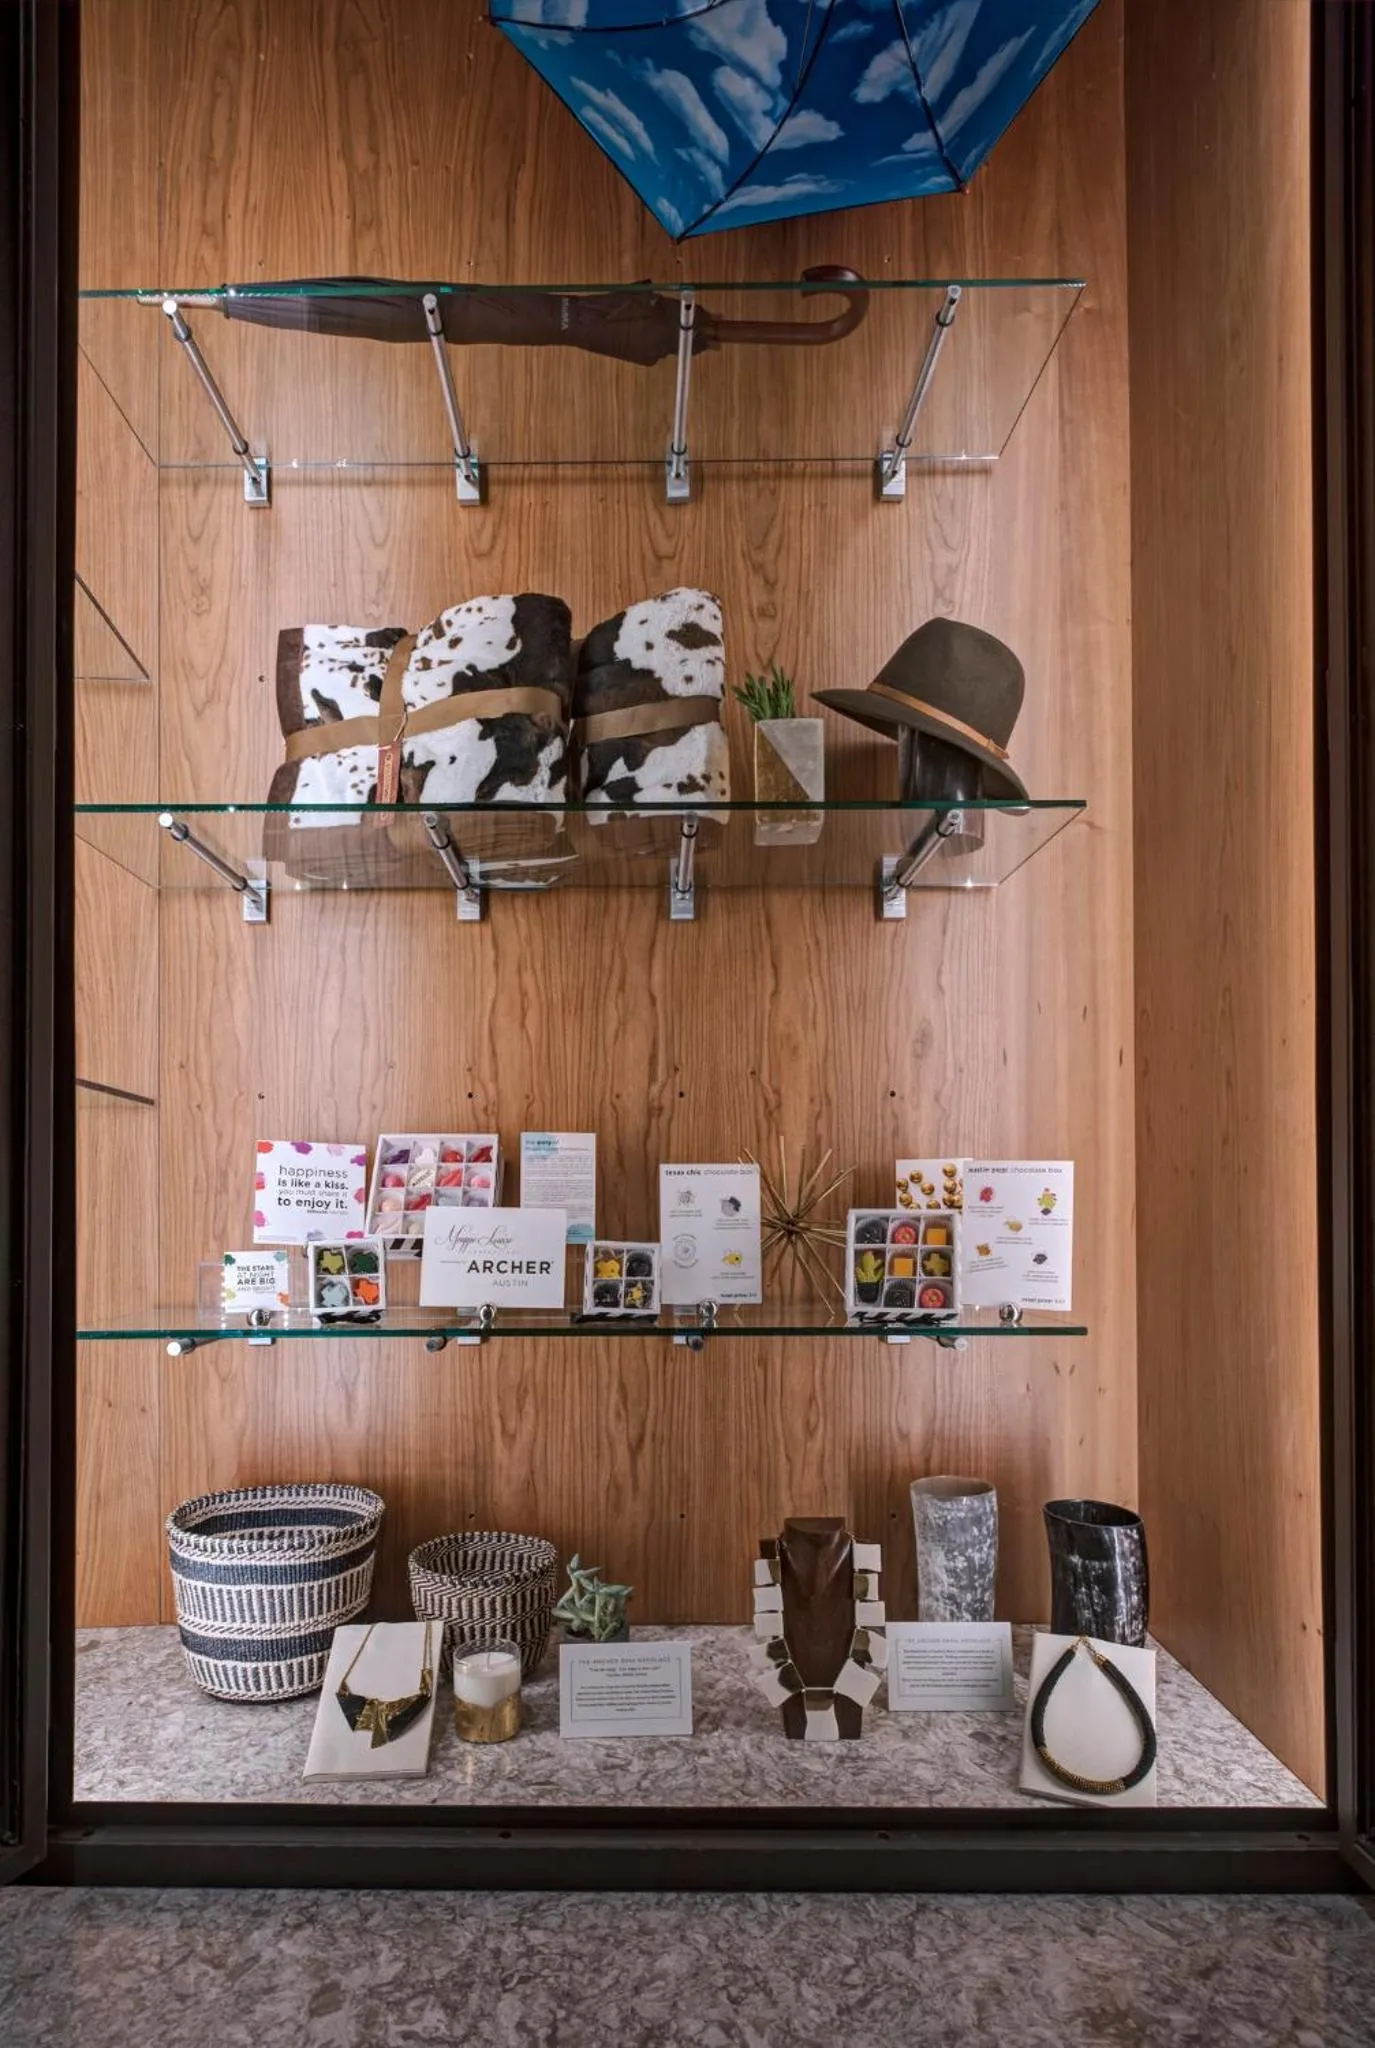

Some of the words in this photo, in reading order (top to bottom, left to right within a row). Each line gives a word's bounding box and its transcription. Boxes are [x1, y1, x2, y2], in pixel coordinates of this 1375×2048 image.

[279, 1165, 348, 1179] happiness
[664, 1168, 685, 1176] texas
[278, 1178, 287, 1187] is
[291, 1179, 311, 1188] like
[325, 1181, 349, 1190] kiss.
[277, 1197, 291, 1207] to
[296, 1199, 332, 1209] enjoy
[336, 1199, 349, 1209] it.
[467, 1260, 552, 1275] ARCHER
[237, 1278, 256, 1286] ARE
[259, 1277, 276, 1286] BIG
[492, 1278, 528, 1288] AUSTIN
